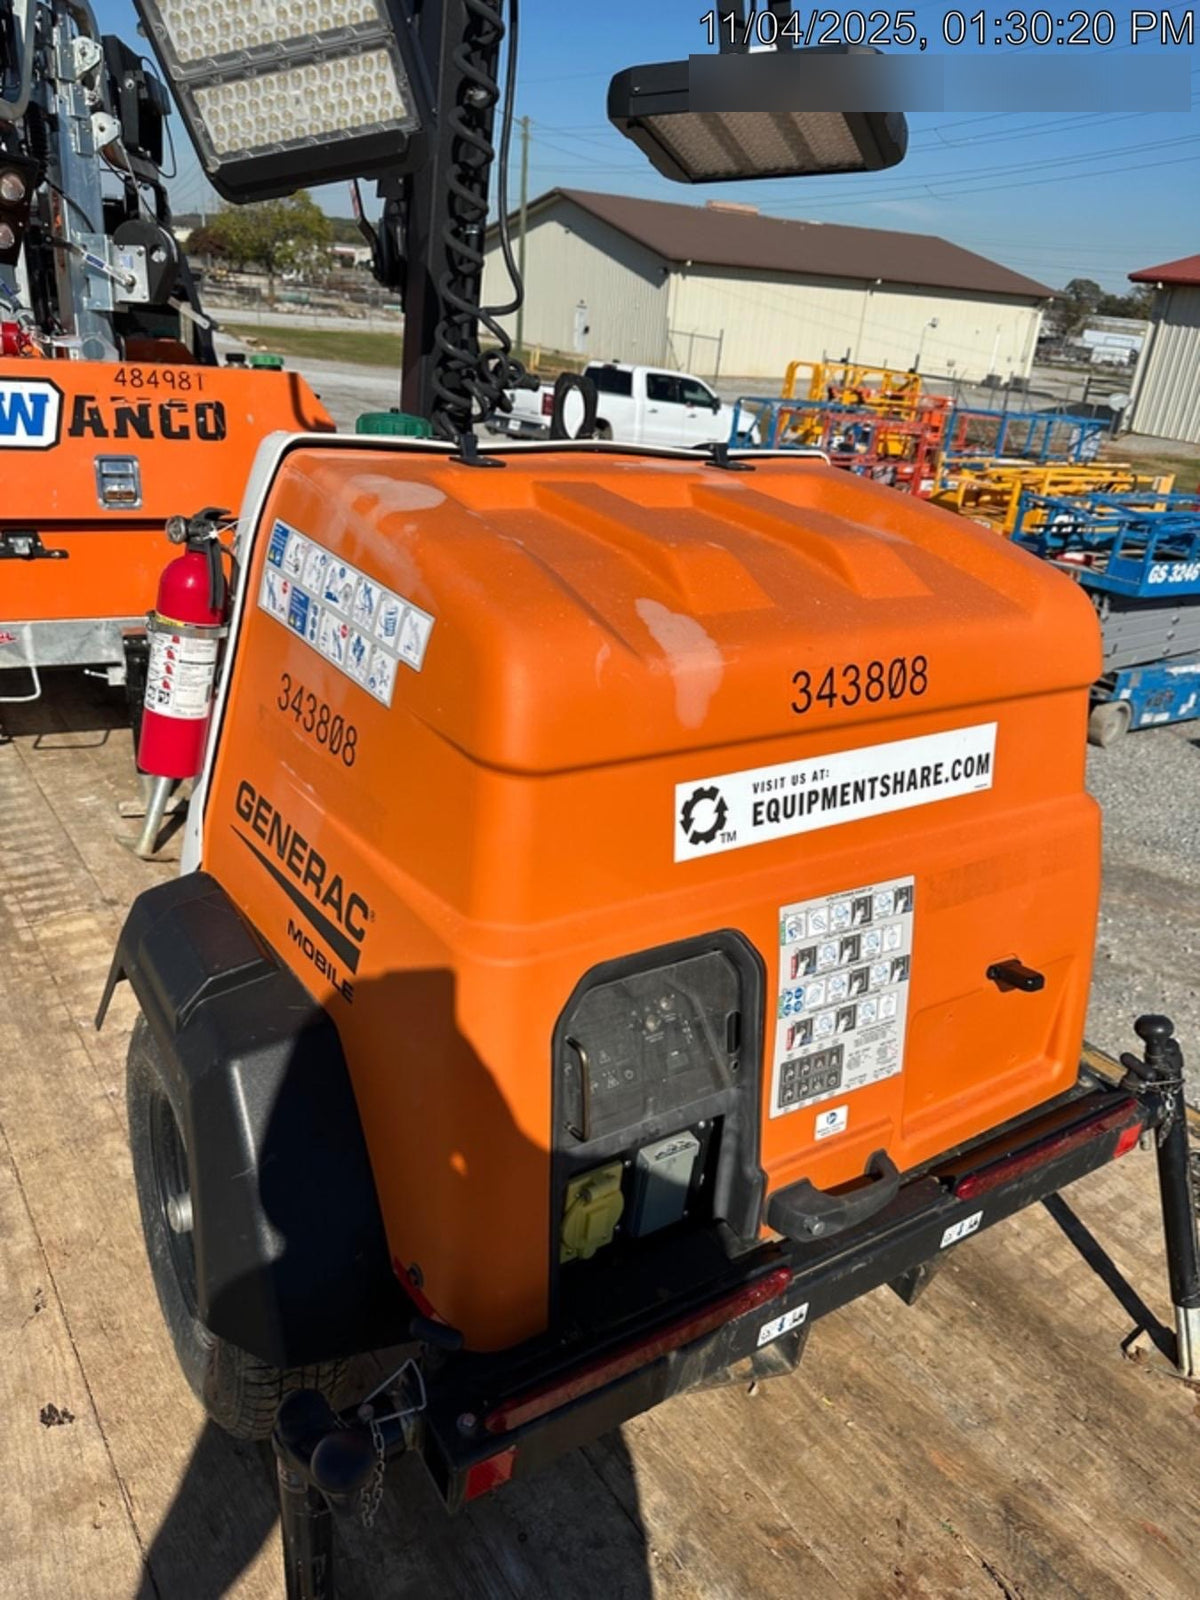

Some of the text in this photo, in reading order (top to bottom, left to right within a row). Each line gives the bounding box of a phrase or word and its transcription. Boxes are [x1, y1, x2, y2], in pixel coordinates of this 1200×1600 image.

[114, 367, 203, 391] 484981
[1148, 564, 1169, 584] GS
[790, 654, 928, 714] 343808
[277, 673, 358, 767] 343808
[751, 752, 990, 827] EQUIPMENTSHARE.COM
[752, 768, 830, 795] VISIT US AT:
[234, 779, 372, 943] GENERAC
[720, 830, 737, 844] TM
[286, 918, 354, 1005] MOBILE
